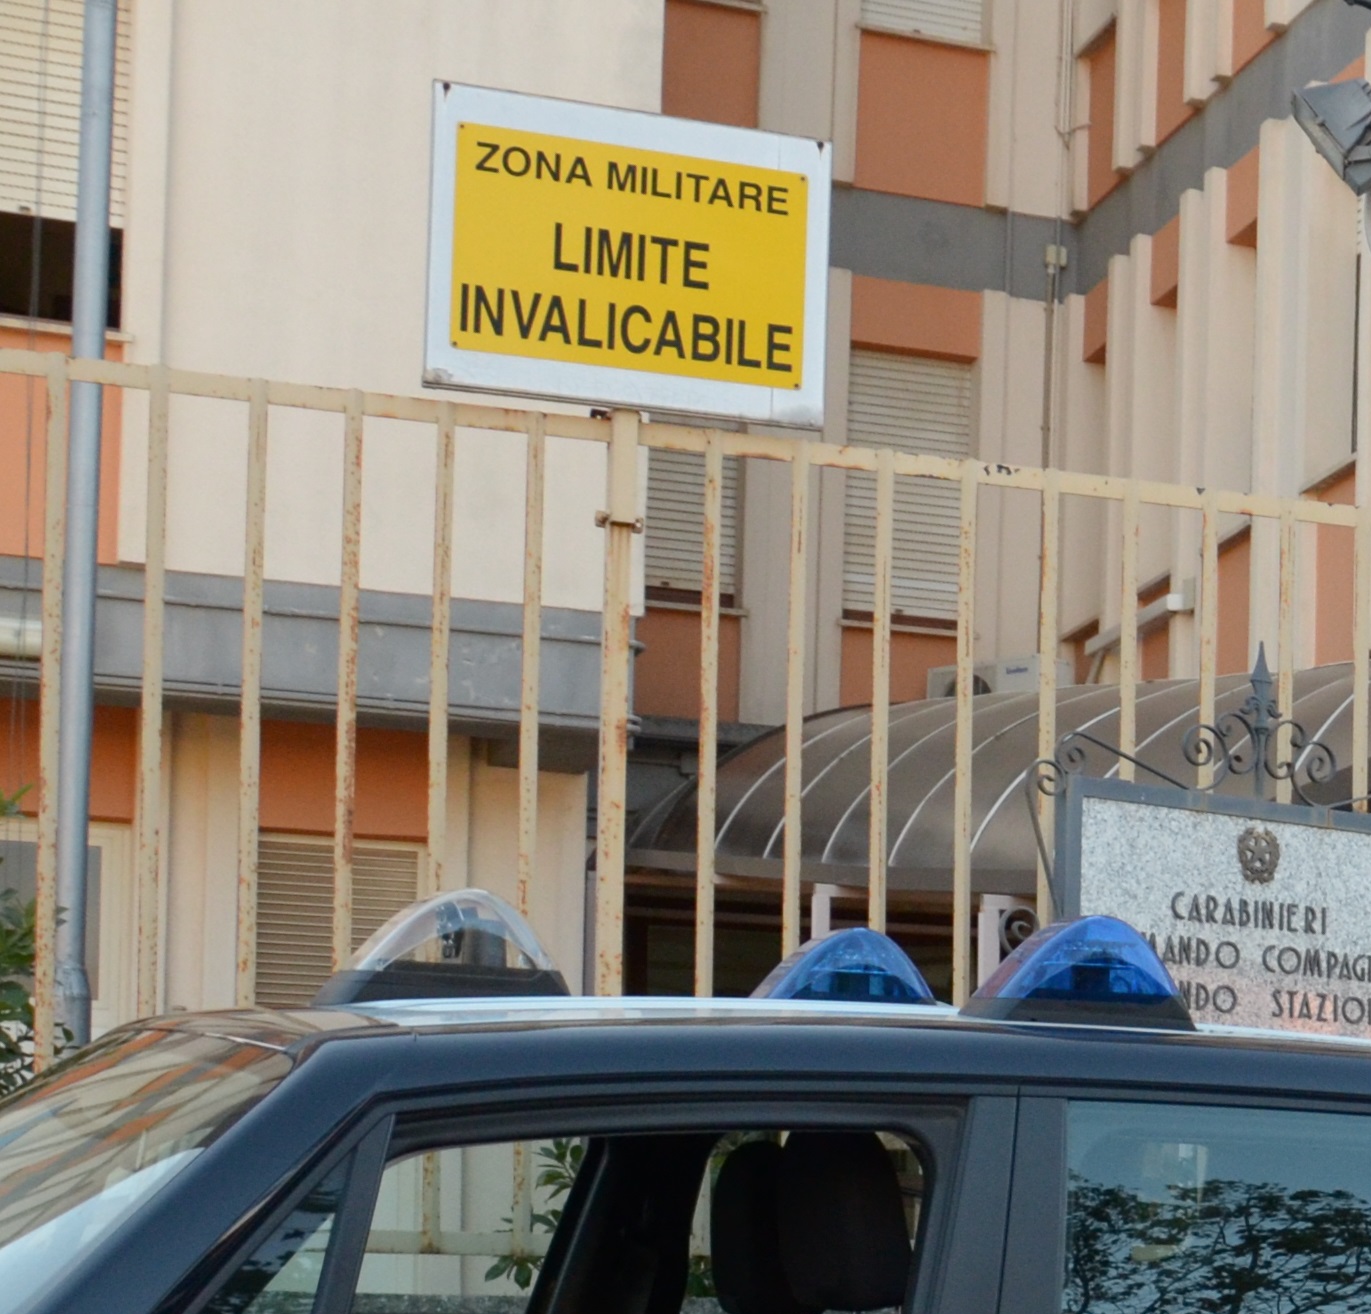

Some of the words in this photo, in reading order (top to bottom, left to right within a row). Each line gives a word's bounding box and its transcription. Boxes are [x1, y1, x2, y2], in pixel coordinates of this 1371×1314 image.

[475, 140, 593, 187] ZONA
[606, 161, 790, 216] MILITARE
[552, 222, 711, 290] LIMITE
[459, 283, 793, 372] INVALICABILE
[1171, 890, 1328, 935] CARABINIERI
